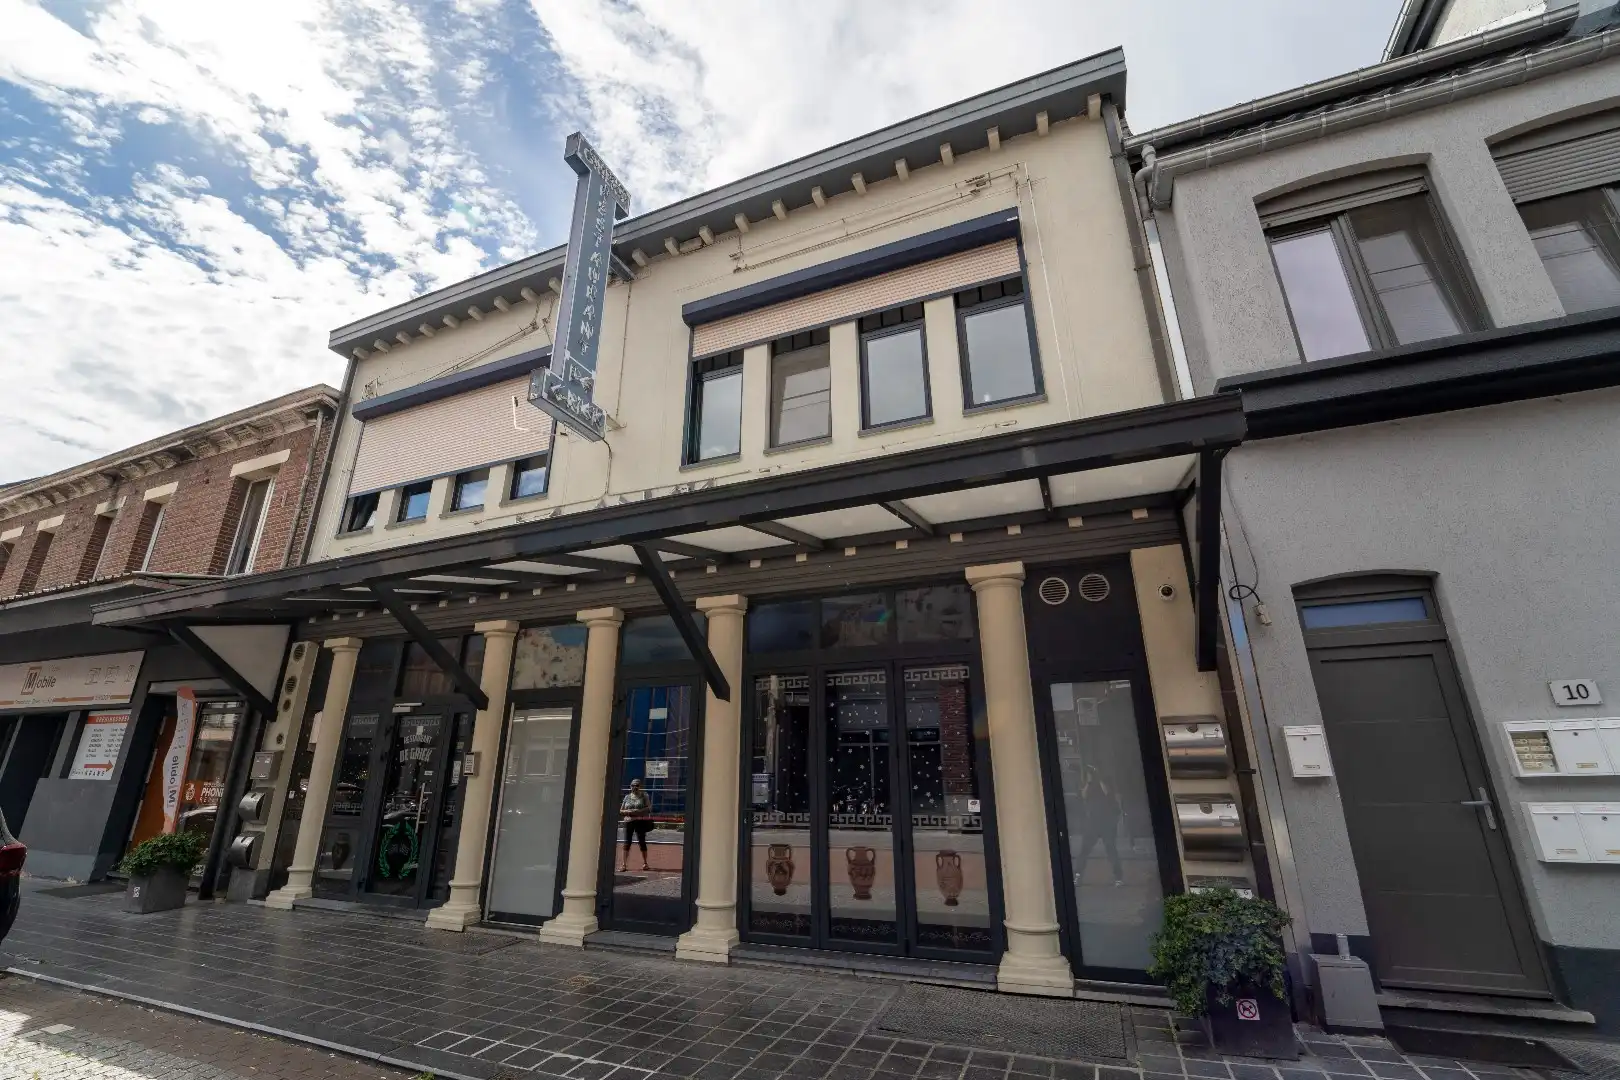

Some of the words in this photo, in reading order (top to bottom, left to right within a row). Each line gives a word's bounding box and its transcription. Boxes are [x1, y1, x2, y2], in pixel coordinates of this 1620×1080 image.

[579, 184, 609, 356] RESTAURANT
[24, 671, 57, 690] Mobile
[1562, 683, 1590, 700] 10
[403, 735, 433, 744] RESTAURANT
[168, 755, 179, 804] Mobile
